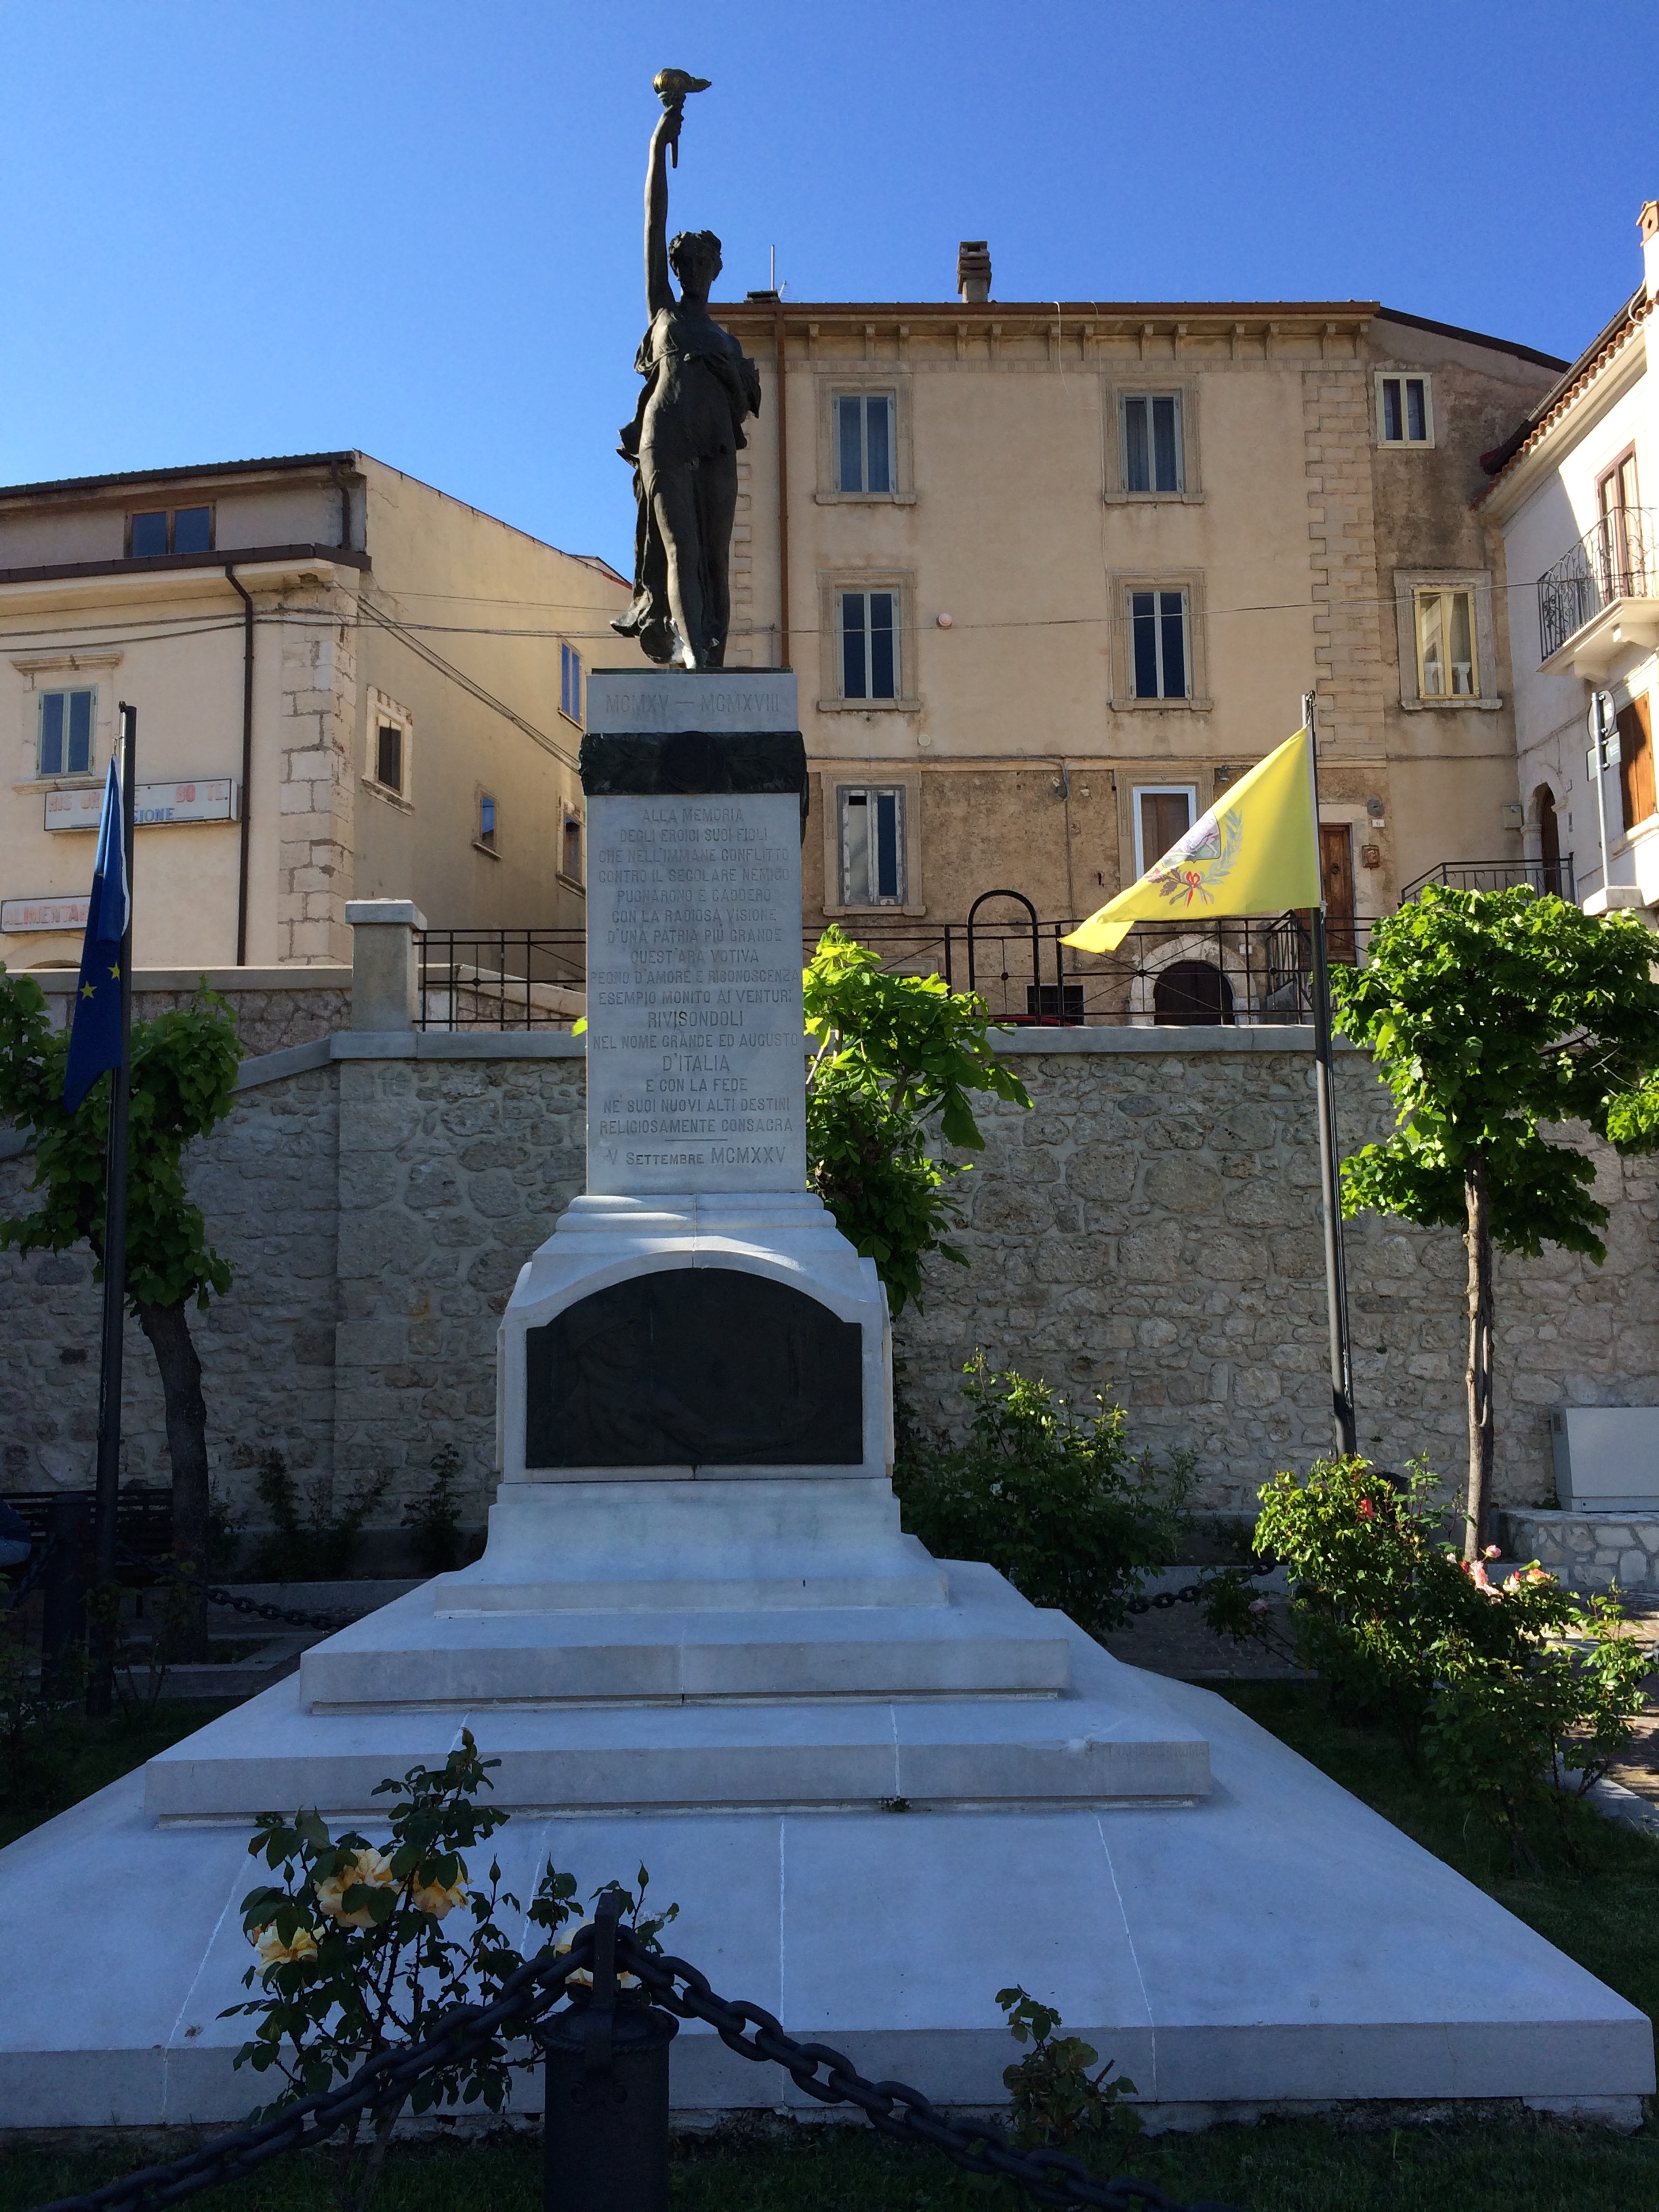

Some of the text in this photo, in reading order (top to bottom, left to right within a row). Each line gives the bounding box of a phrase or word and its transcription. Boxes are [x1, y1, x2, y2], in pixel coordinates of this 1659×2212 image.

[607, 694, 670, 712] MCMXV
[699, 693, 779, 712] MCMXVIII
[643, 808, 744, 822] ALLA MEMORIA
[620, 828, 768, 842] DEGLI EROICI SUOI FIGLI
[599, 847, 790, 863] CHE NELL'IMMANE CONFLITTO
[599, 868, 790, 883] CONTRO IL SECOLARE NEMICO
[617, 888, 771, 903] PUGNARONO E CADDERO
[612, 908, 777, 924] CON LA RADIOSA VISIONE
[608, 928, 647, 944] D'UNA
[653, 929, 699, 943] PATRIA
[730, 928, 782, 943] GRANDE
[711, 949, 759, 963] VOTIVA
[590, 968, 800, 985] PEGNO D'AMORE E RICONOSCENZA
[599, 989, 792, 1006] ESEMPIO MONITO AI VENTURI
[648, 1010, 743, 1029] RIVISONDOLI
[593, 1033, 798, 1050] NEL NOME GRANDE ED AUGUSTO
[663, 1053, 731, 1071] D'ITALIA
[646, 1078, 747, 1092] E CON LA FEDE
[627, 1099, 655, 1113] SUOI
[661, 1099, 701, 1113] NUOVI
[706, 1098, 735, 1111] ALTI
[741, 1097, 790, 1111] DESTINI
[600, 1118, 793, 1135] RELIGIOSAMENTE CONSACRA
[712, 1147, 786, 1164] MCMXXV
